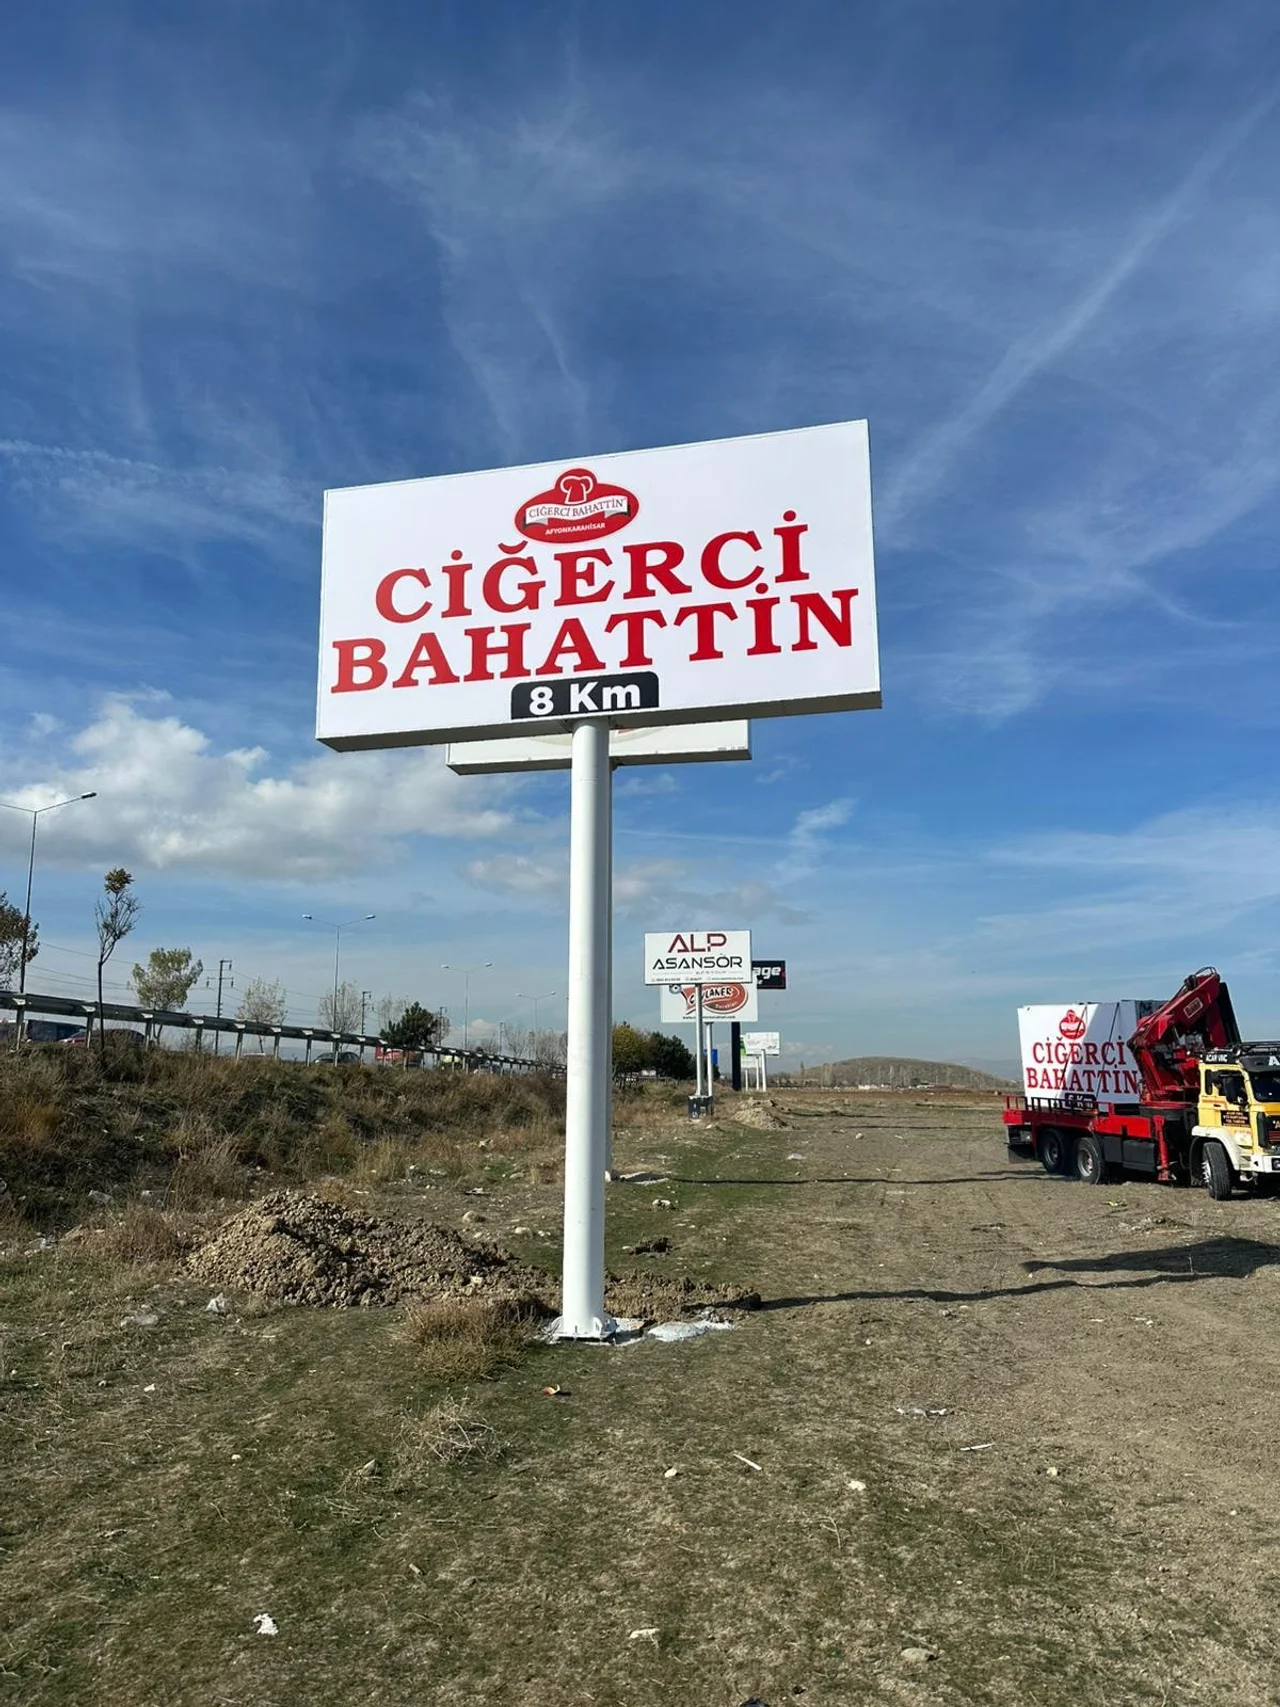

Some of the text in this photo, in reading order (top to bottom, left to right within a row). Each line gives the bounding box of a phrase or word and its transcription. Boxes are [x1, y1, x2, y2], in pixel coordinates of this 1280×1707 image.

[528, 497, 625, 519] CİĞERCİ BAHATTİN
[545, 521, 606, 536] AFYONKARAHİSAR
[375, 510, 809, 623] CİĞERCİ
[331, 582, 859, 694] BAHATTİN
[529, 681, 641, 716] 8 Km
[667, 933, 727, 953] ALP
[1032, 1035, 1126, 1065] CİĞERCİ
[1026, 1064, 1139, 1094] BAHATTİN
